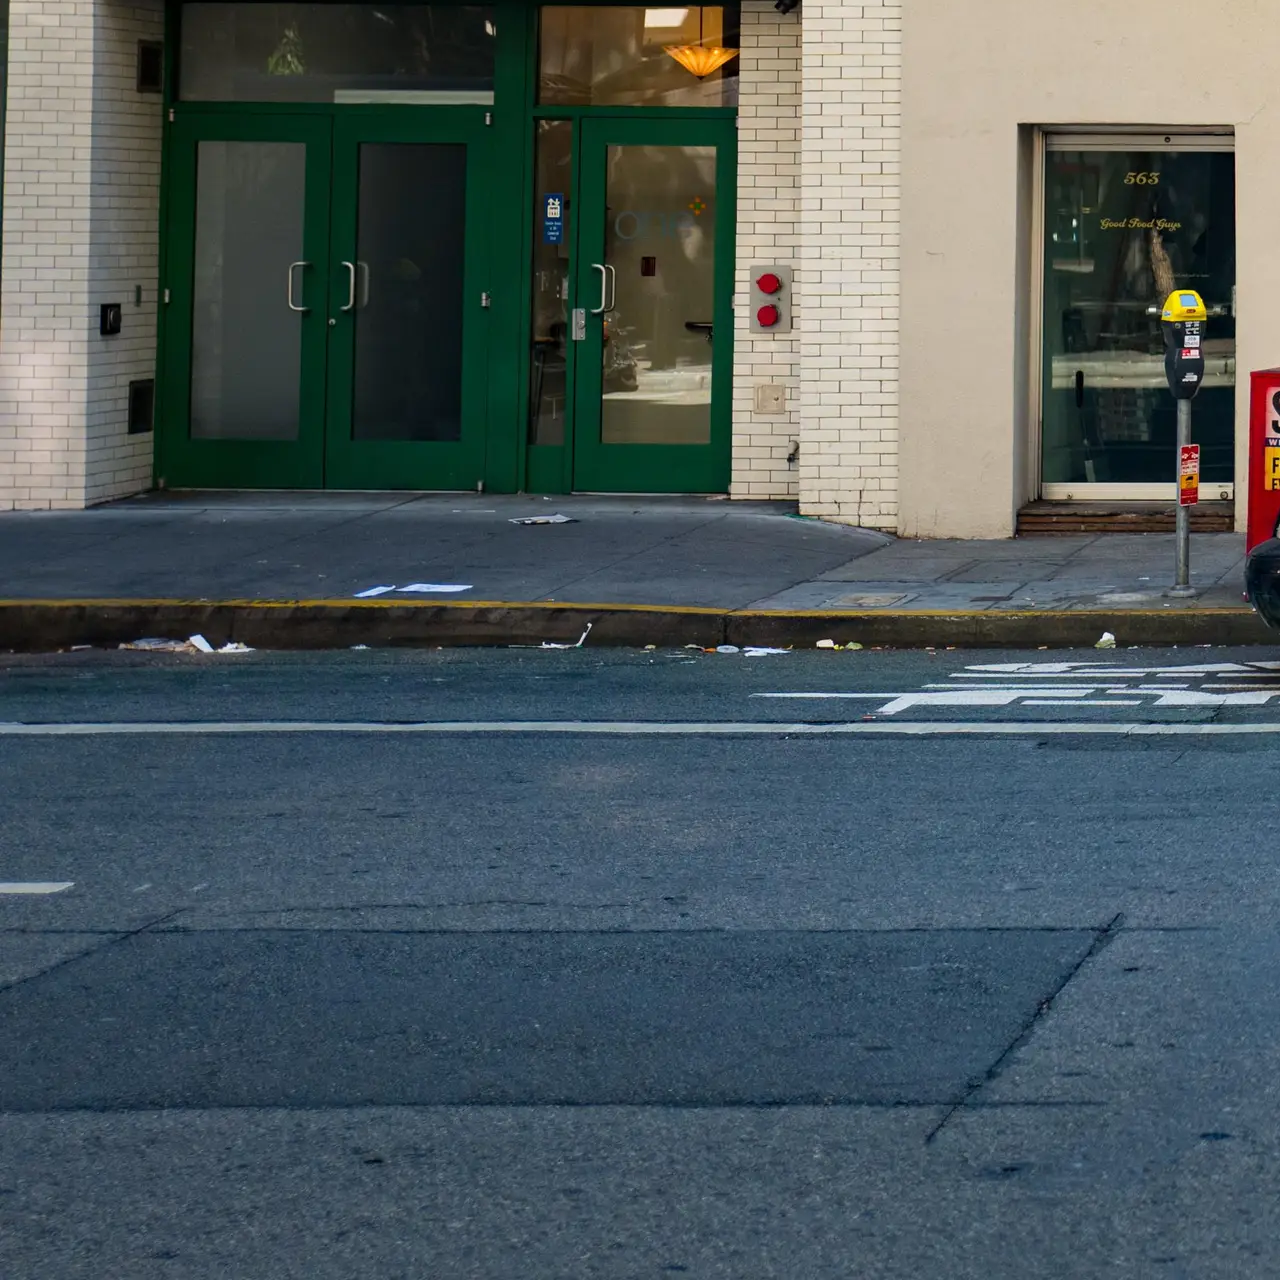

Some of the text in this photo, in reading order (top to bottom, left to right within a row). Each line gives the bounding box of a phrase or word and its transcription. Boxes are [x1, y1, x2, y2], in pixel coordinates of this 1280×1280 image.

[1124, 171, 1160, 185] 563
[1100, 218, 1182, 231] Good Food Guys
